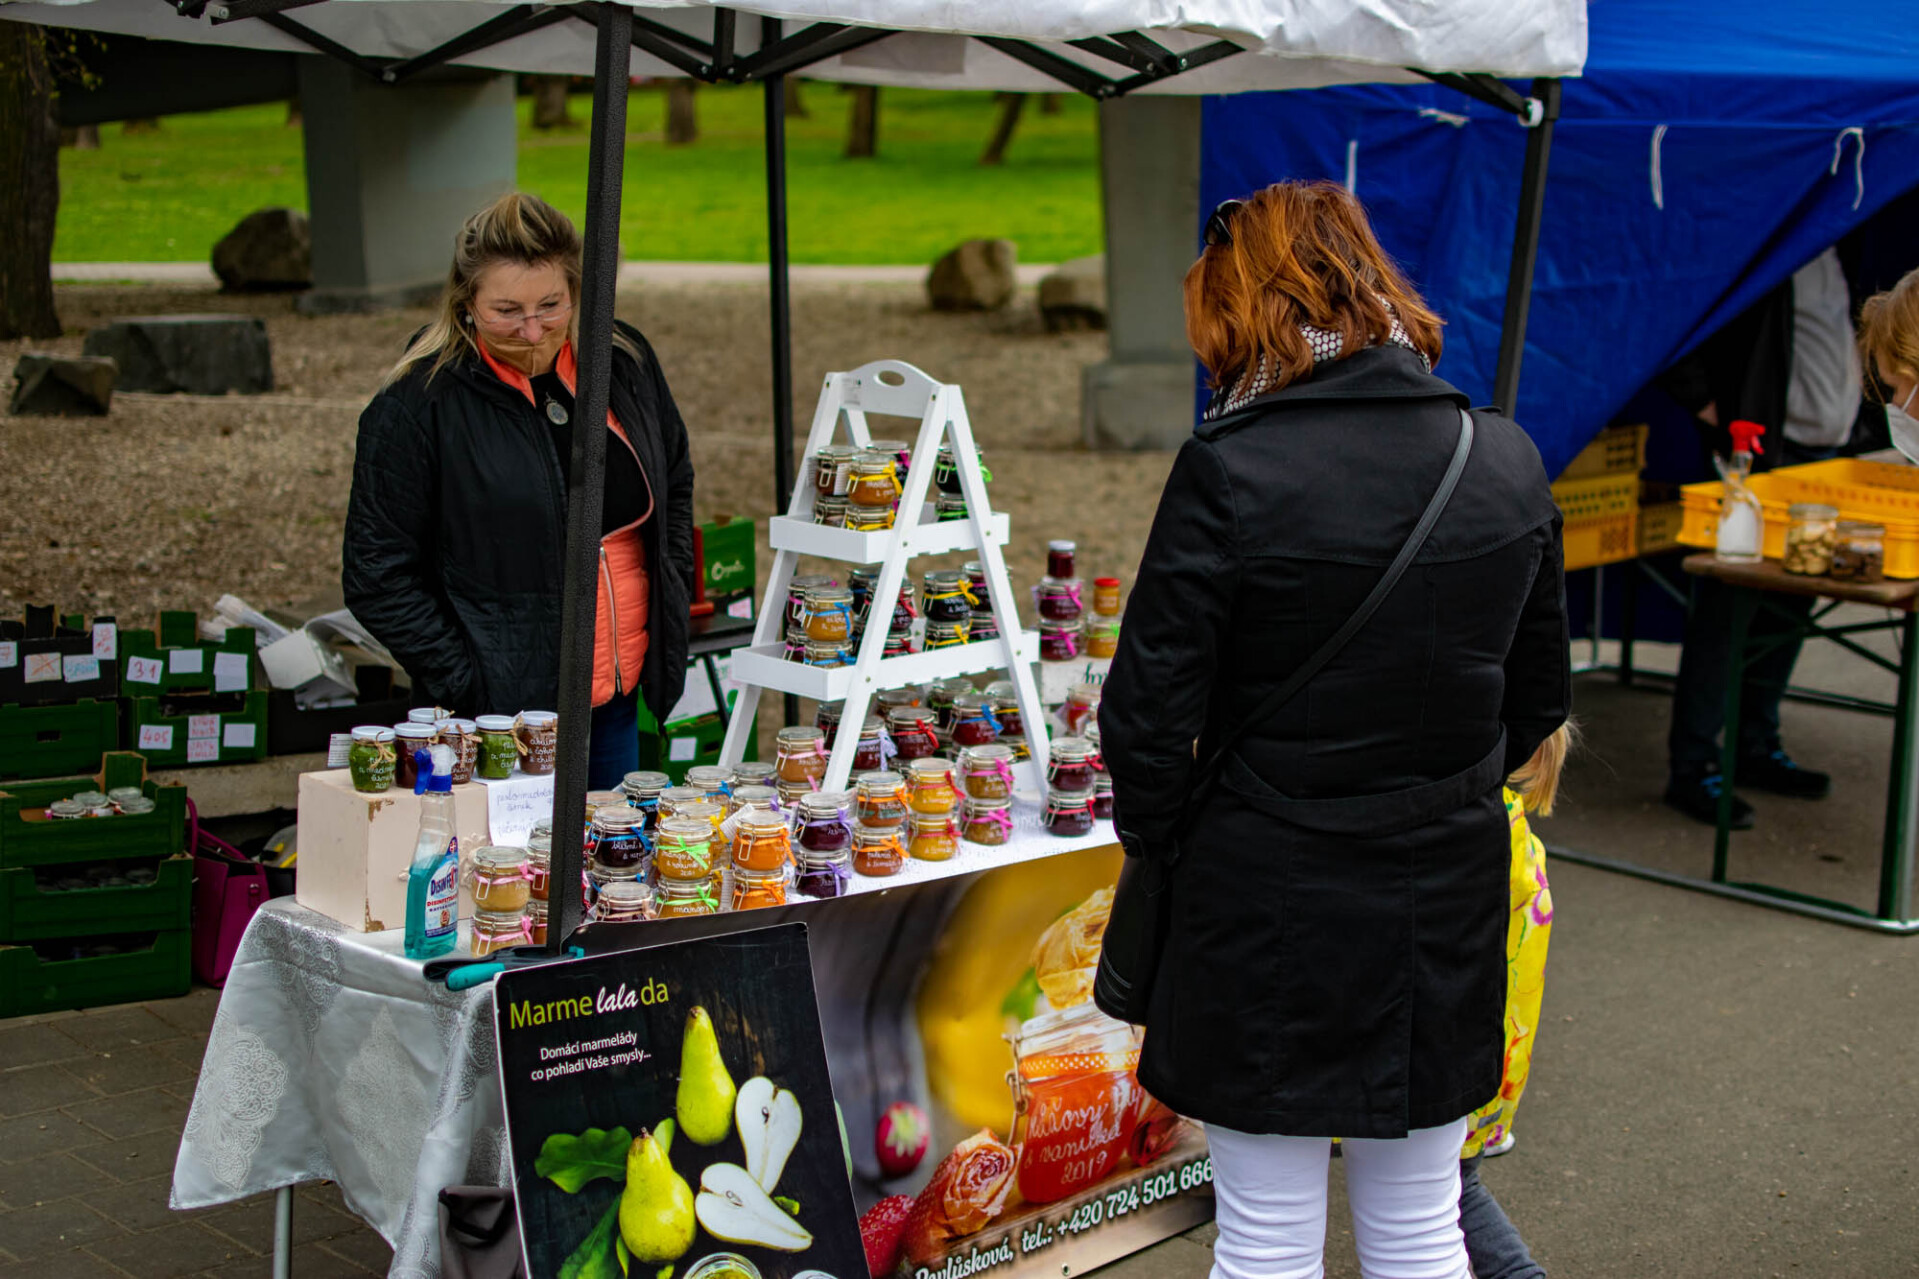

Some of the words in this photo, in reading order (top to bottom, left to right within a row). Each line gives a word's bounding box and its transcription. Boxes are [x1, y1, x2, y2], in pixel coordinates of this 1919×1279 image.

[540, 1041, 580, 1061] Domácí
[581, 1031, 637, 1051] marmelády
[531, 1069, 544, 1080] co
[546, 1060, 584, 1080] pohladí
[585, 1052, 610, 1070] Vaše
[611, 1048, 651, 1065] smysly...
[1061, 1150, 1108, 1184] 2019
[1057, 1200, 1103, 1235] +420
[1106, 1186, 1140, 1219] 724
[1142, 1171, 1178, 1205] 501
[1179, 1157, 1214, 1191] 666
